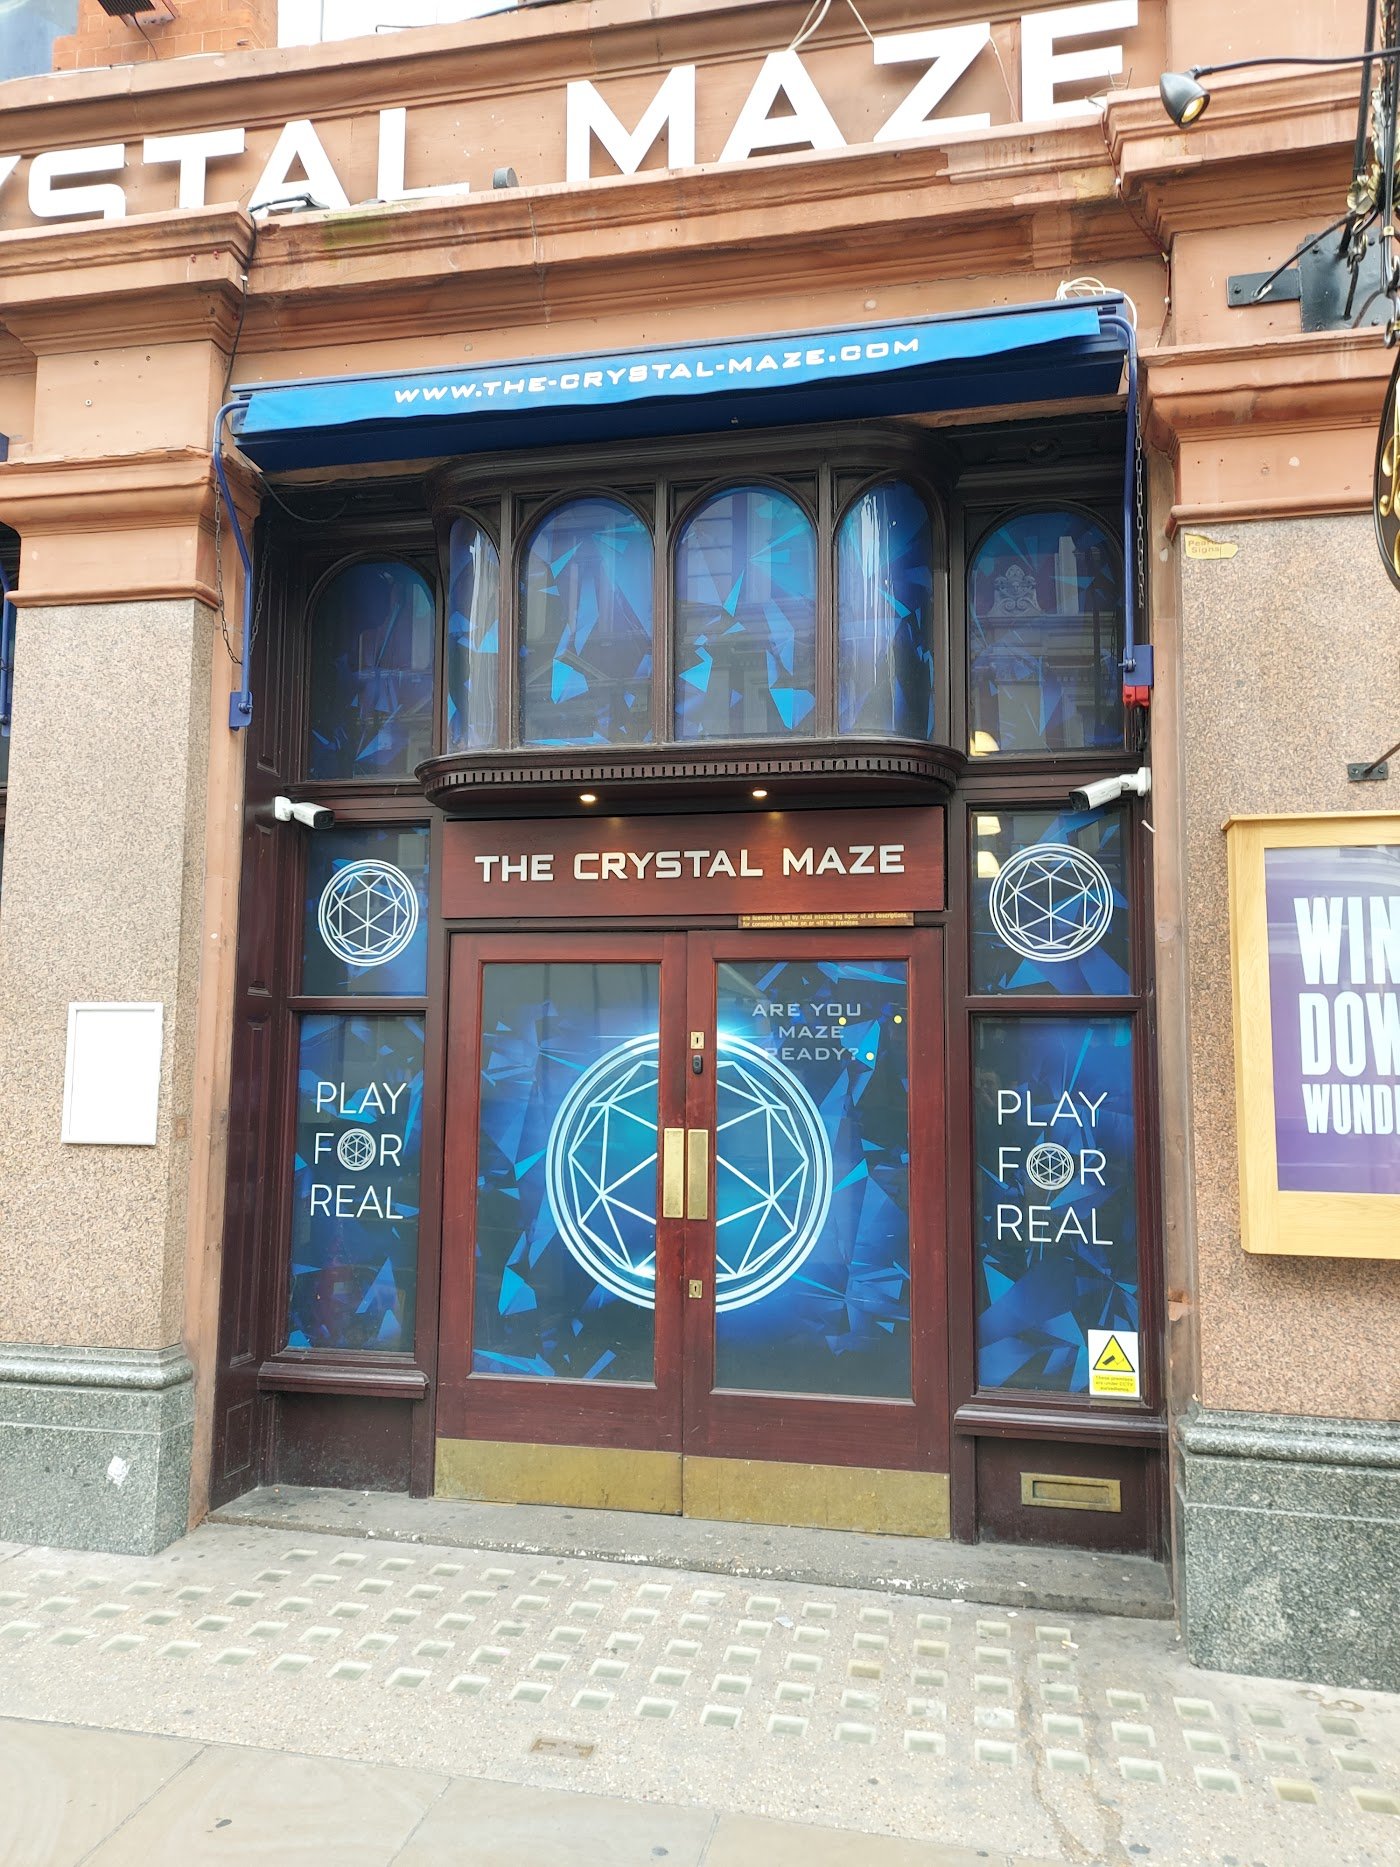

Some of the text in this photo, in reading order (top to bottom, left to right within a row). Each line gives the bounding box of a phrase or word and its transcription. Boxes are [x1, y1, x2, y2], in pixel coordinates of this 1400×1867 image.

[0, 0, 1139, 219] STAL MAZE
[394, 338, 919, 403] WWW.THE-CRYSTAL-MAZE.COM
[474, 844, 905, 883] THE CRYSTAL MAZE
[751, 1003, 861, 1017] ARE YOU
[778, 1025, 845, 1039] MAZE
[316, 1081, 407, 1115] PLAY
[997, 1089, 1108, 1128] PLAY
[1302, 1083, 1400, 1135] WUND
[310, 1183, 404, 1220] REAL
[997, 1204, 1114, 1246] REAL
